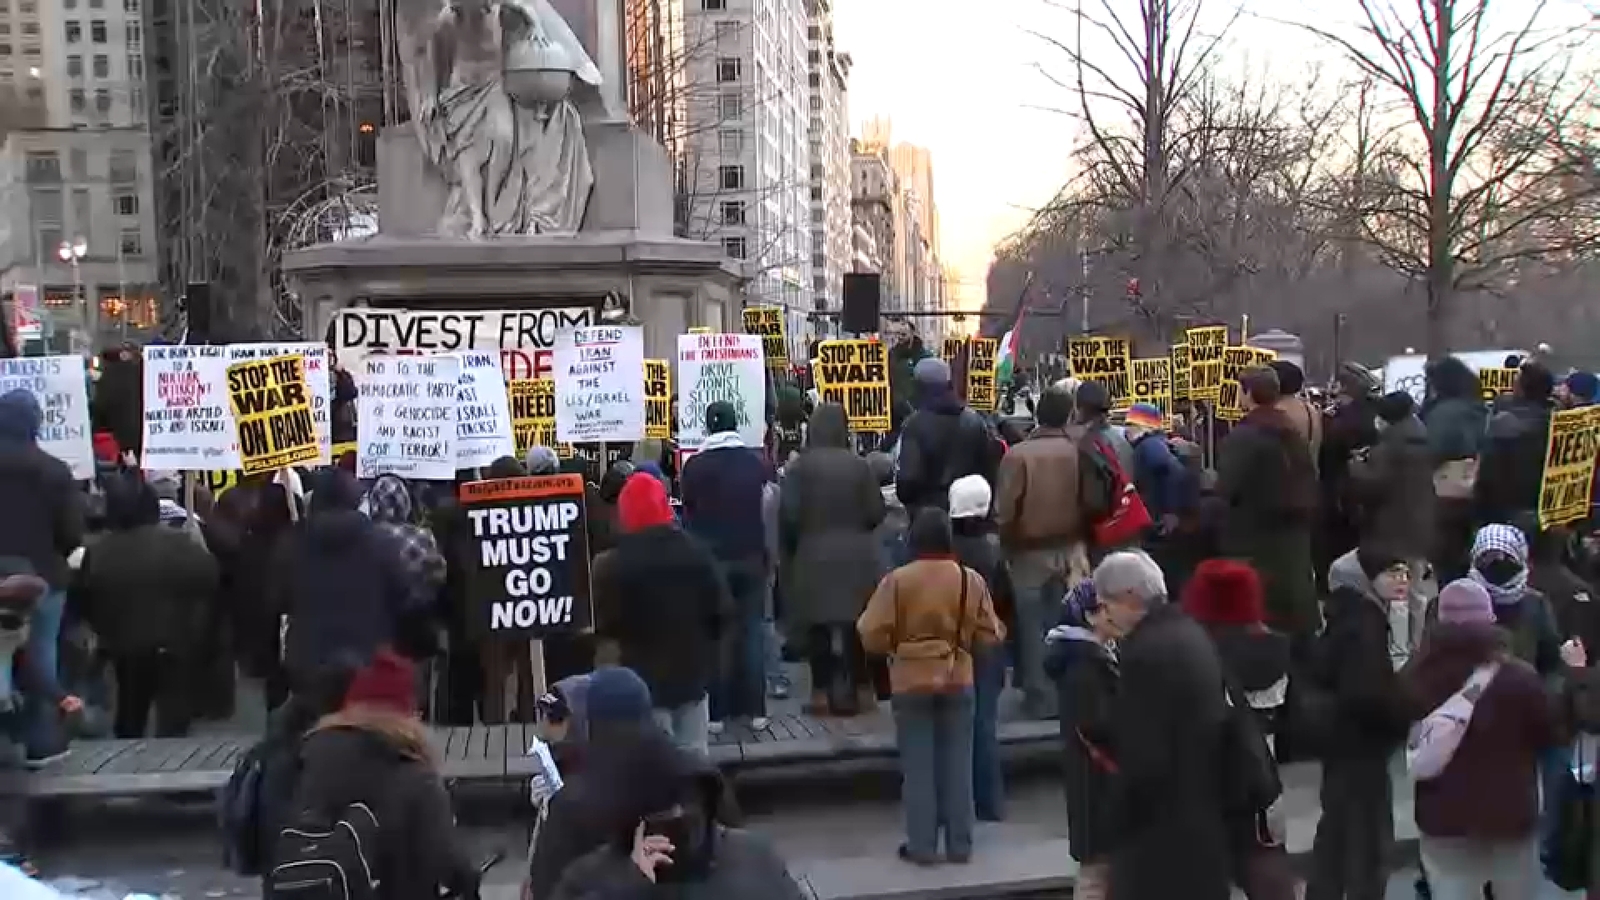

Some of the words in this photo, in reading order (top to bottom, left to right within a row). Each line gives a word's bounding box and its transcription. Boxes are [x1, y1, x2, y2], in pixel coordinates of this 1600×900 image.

[744, 312, 760, 324] STOP
[763, 311, 779, 323] THE
[342, 312, 483, 350] DIVEST
[500, 310, 590, 350] FROM
[574, 329, 623, 343] DEFEND
[744, 323, 781, 336] WAR
[699, 335, 741, 349] DEFEND
[1190, 332, 1210, 345] STOP
[231, 349, 256, 359] IRAN
[579, 347, 612, 361] IRAN
[820, 344, 855, 364] STOP
[858, 343, 884, 363] THE
[1071, 341, 1100, 358] STOP
[1103, 340, 1126, 356] THE
[1191, 346, 1223, 361] WAR
[1224, 350, 1253, 365] STOP
[186, 361, 193, 371] A
[367, 361, 386, 374] NO
[397, 360, 409, 374] TO
[568, 362, 616, 376] AGAINST
[646, 362, 667, 381] THE
[1072, 357, 1126, 373] WAR
[1134, 361, 1169, 381] HANDS
[229, 364, 269, 392] STOP
[270, 359, 301, 386] THE
[822, 365, 885, 383] WAR
[971, 376, 991, 386] HE
[360, 383, 420, 399] DEMOCRATIC
[427, 381, 458, 398] PARTY
[577, 377, 601, 390] THE
[1135, 382, 1169, 395] OFF
[232, 382, 305, 415] WAR
[849, 386, 888, 417] IRAN!
[1219, 382, 1238, 408] ON
[395, 406, 451, 421] GENOCIDE
[512, 394, 555, 419] NEED
[645, 400, 667, 426] AN!
[575, 410, 602, 421] WAR
[239, 418, 269, 457] ON
[269, 408, 316, 453] IRAN!
[402, 426, 440, 439] RACIST
[401, 440, 450, 458] TERROR!
[467, 502, 579, 536] TRUMP
[481, 534, 570, 567] MUST
[505, 566, 551, 596] GO
[490, 595, 574, 629] NOW!
